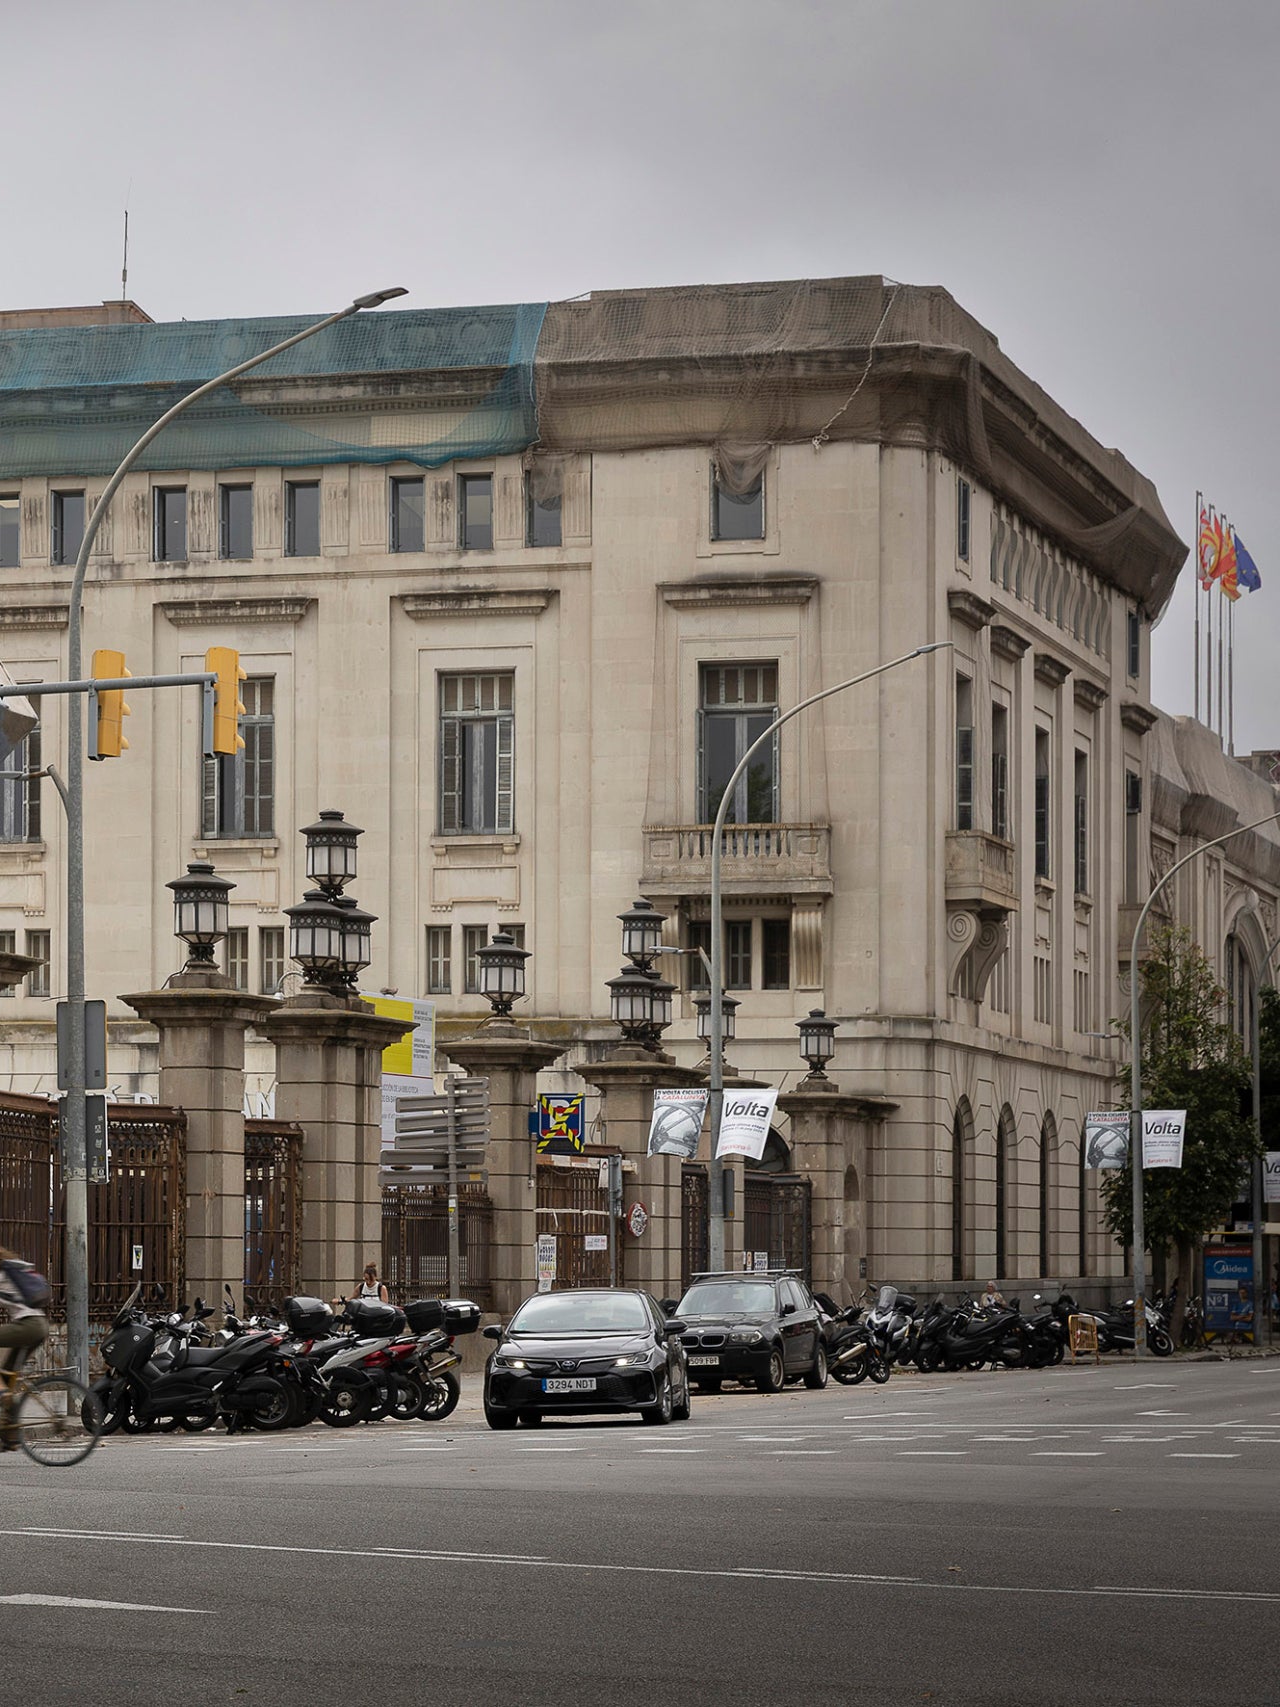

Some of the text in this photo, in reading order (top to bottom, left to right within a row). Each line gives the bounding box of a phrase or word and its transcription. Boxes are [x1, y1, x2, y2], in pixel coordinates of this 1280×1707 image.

[725, 1101, 770, 1118] Volta
[1145, 1122, 1182, 1135] Volta
[1220, 1264, 1248, 1273] Midea
[548, 1380, 594, 1389] 3294 NDT
